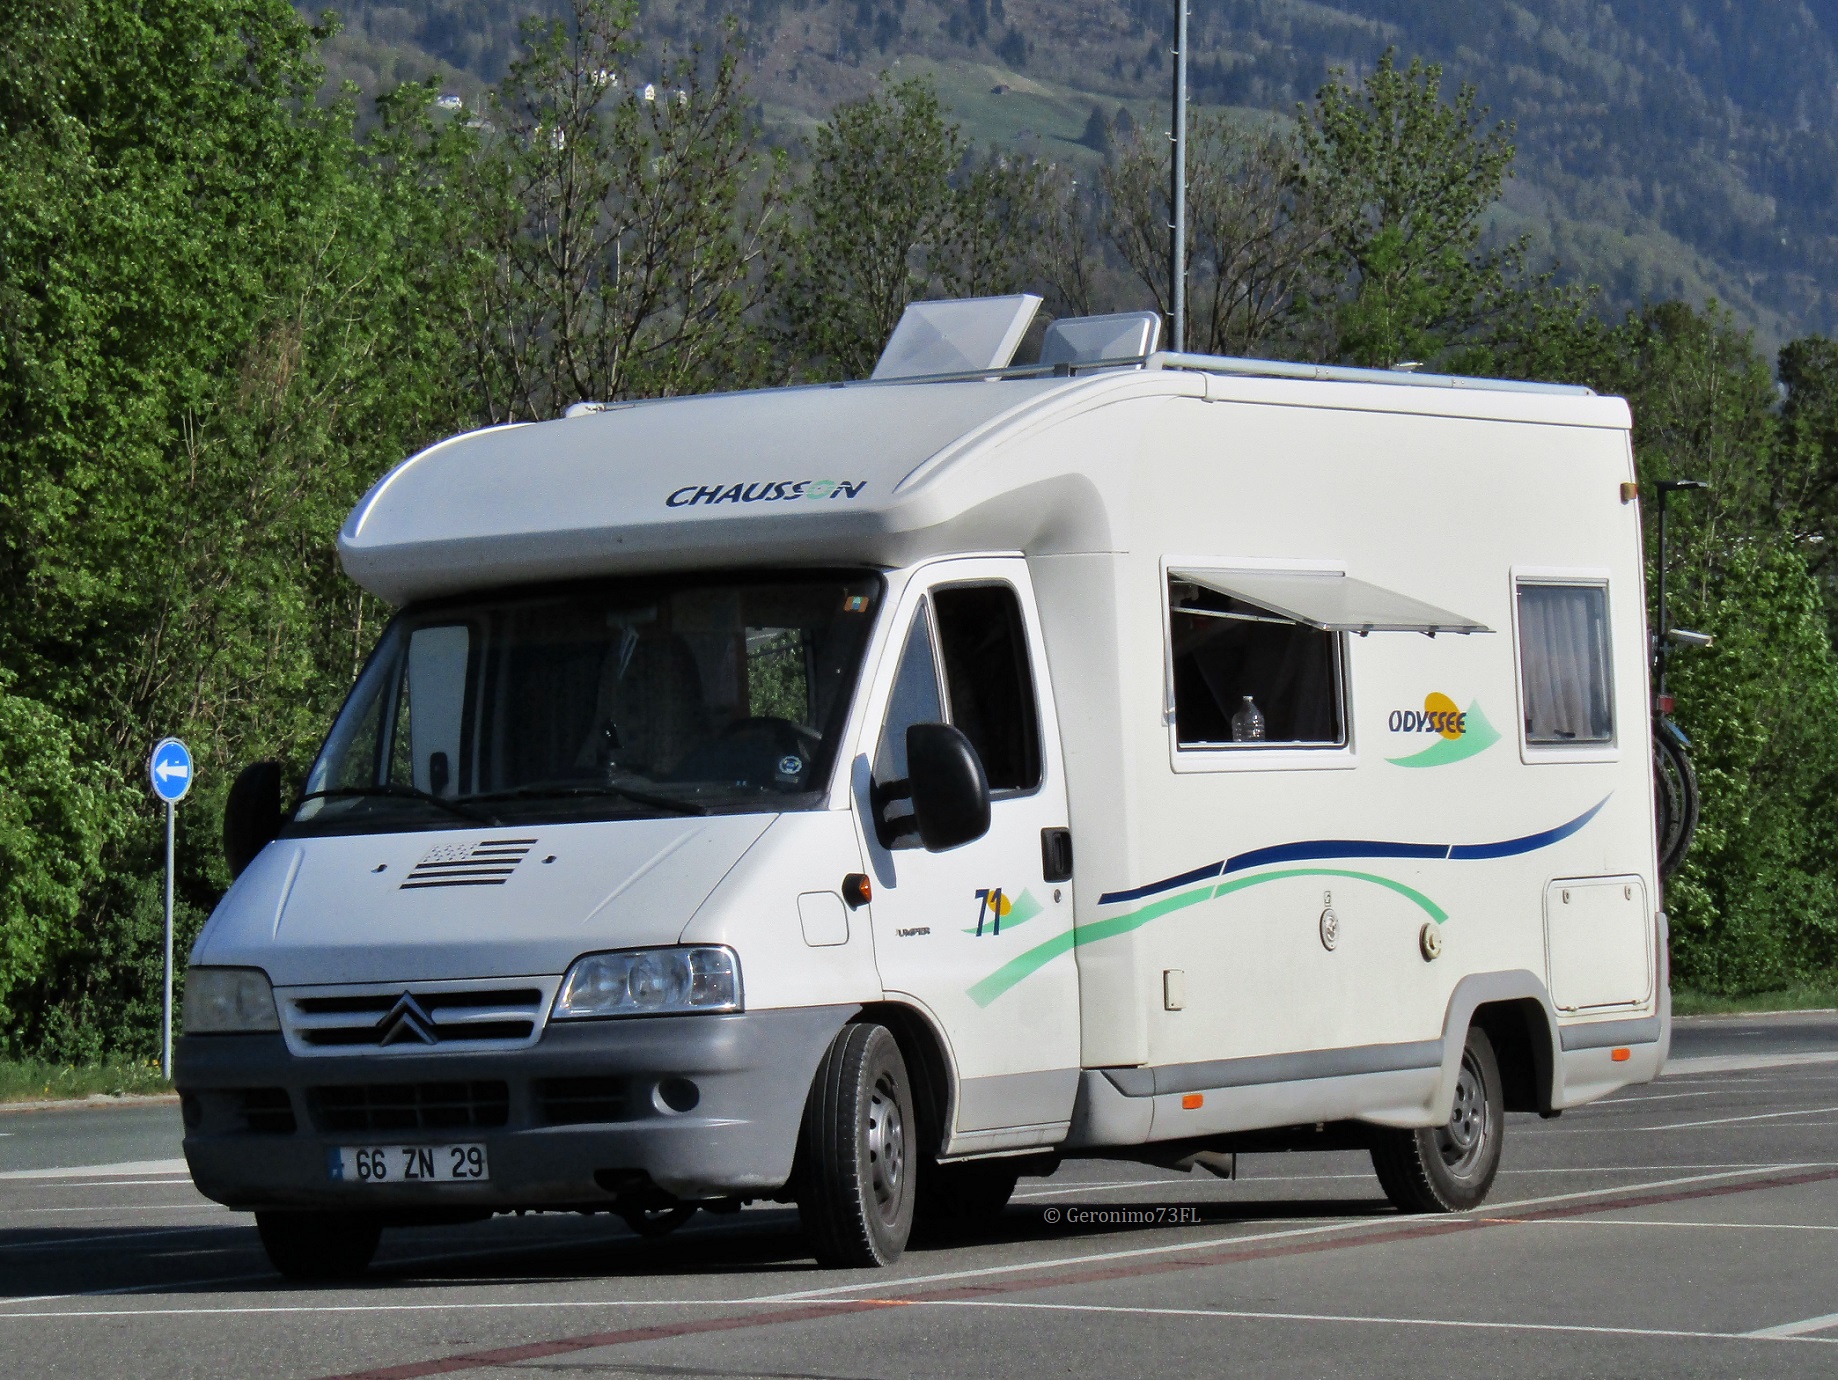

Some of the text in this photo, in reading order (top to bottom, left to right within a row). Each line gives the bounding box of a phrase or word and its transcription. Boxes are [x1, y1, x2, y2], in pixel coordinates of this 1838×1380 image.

[666, 479, 867, 507] CHAUSSON
[1388, 710, 1467, 733] ODYSSEE
[975, 888, 1002, 937] 71
[356, 1147, 483, 1180] 66 ZN 29
